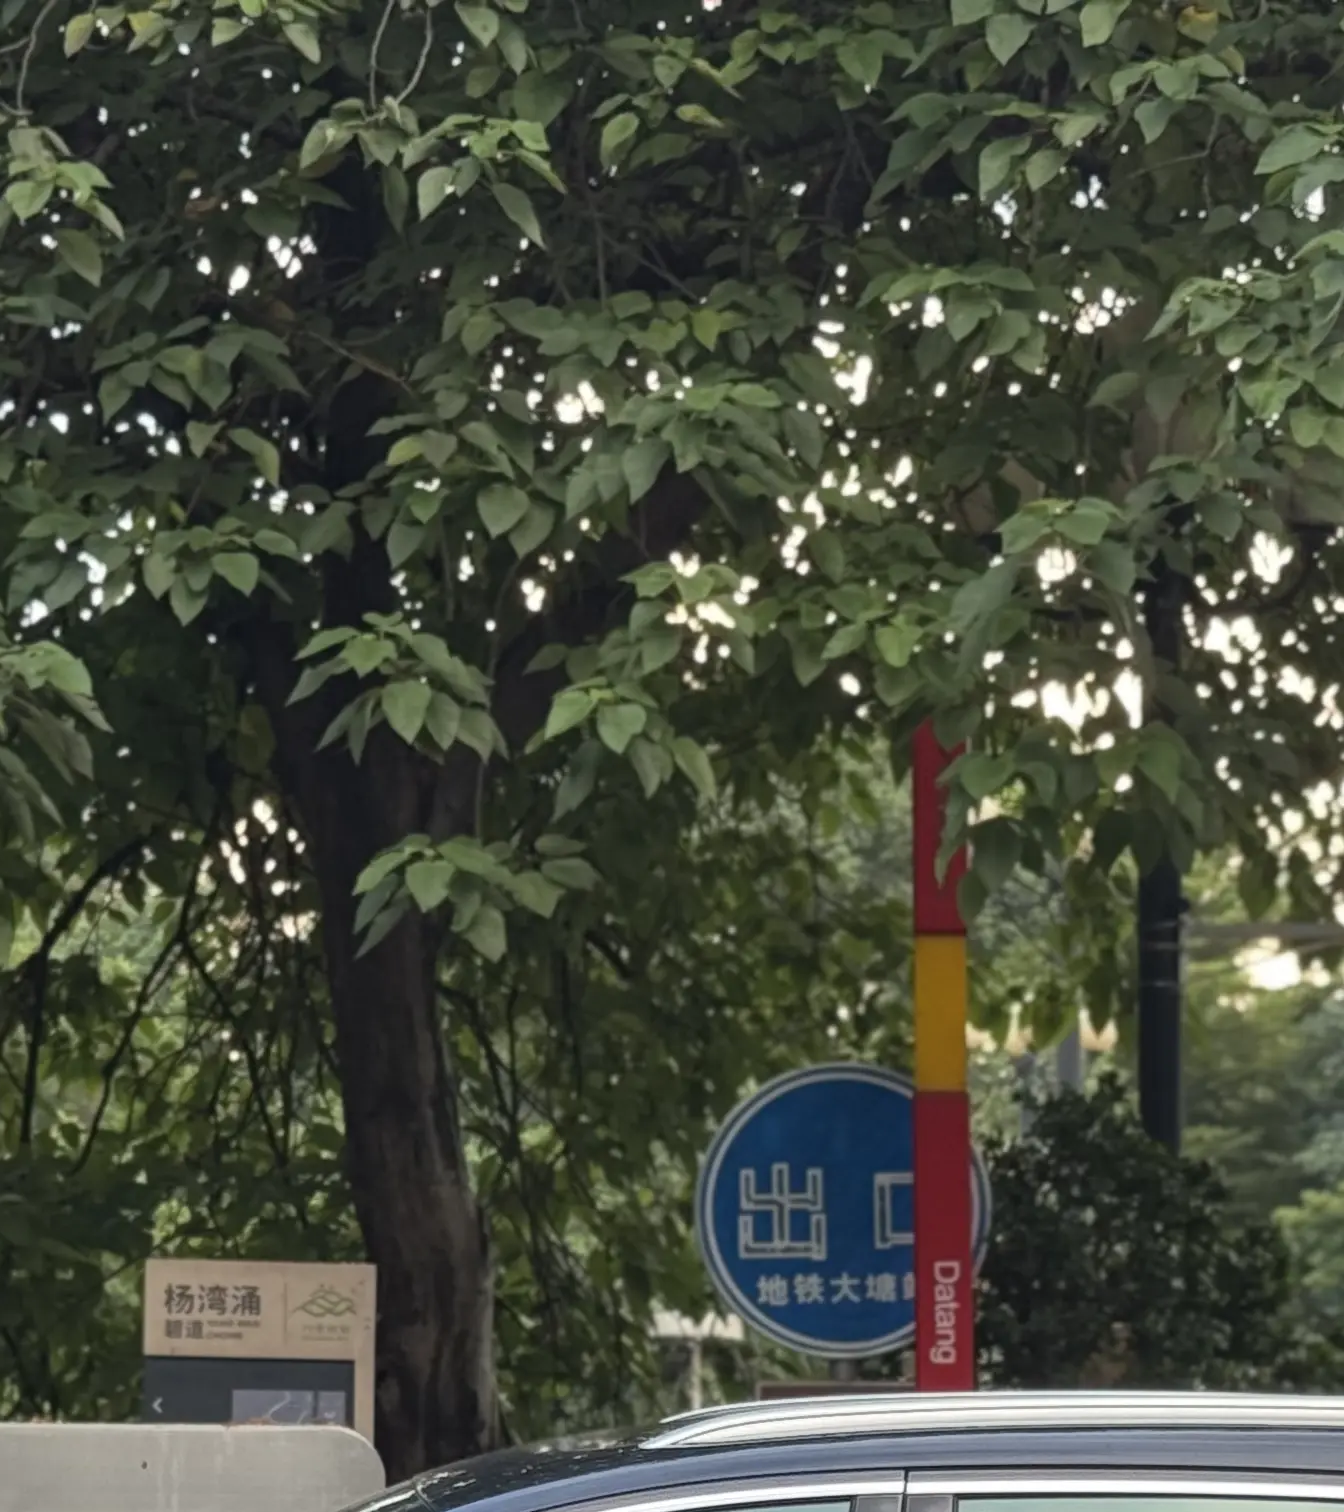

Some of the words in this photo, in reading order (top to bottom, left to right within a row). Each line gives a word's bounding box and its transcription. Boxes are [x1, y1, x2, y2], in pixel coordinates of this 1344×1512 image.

[163, 1283, 261, 1316] 杨湾涌
[928, 1260, 961, 1365] Datang
